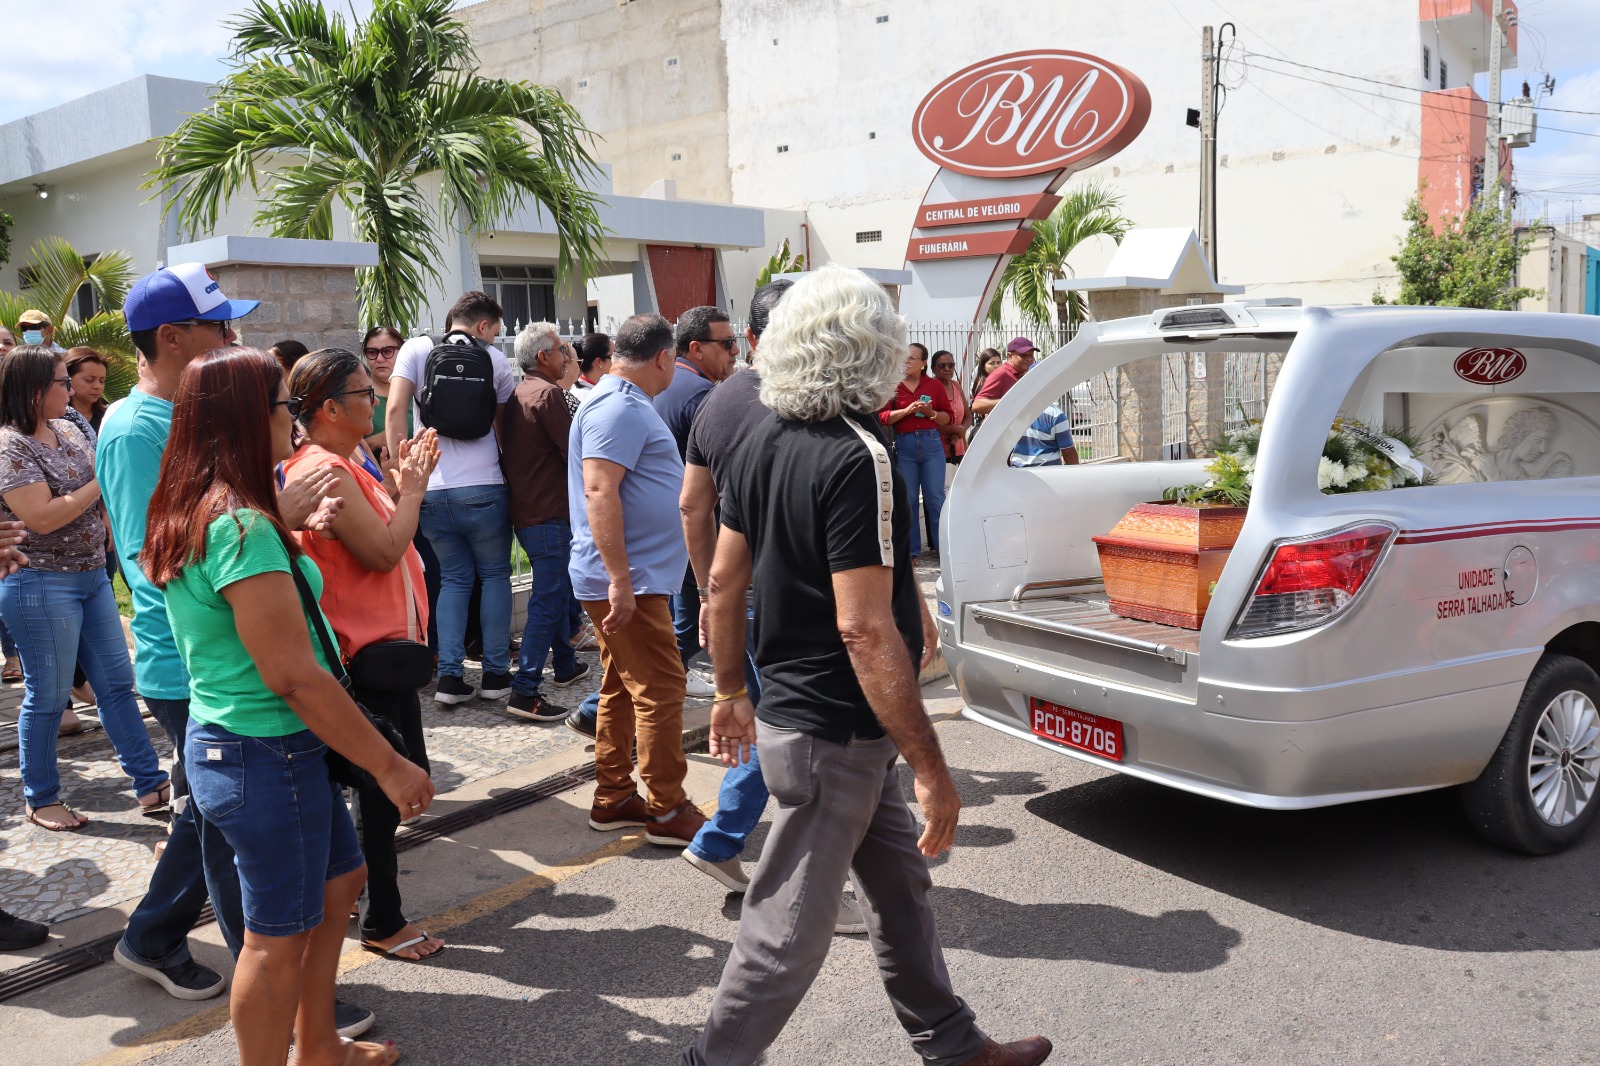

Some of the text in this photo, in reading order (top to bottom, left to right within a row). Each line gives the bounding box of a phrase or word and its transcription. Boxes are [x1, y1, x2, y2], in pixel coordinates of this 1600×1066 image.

[934, 66, 1099, 156] BM
[926, 202, 1021, 221] CENTRAL DE VELÓRIO
[919, 240, 969, 254] FUNERÁRIA
[1460, 350, 1517, 379] BM
[1458, 569, 1496, 590] UNIDADE:
[1437, 591, 1515, 619] SERRA TALHADA/PE
